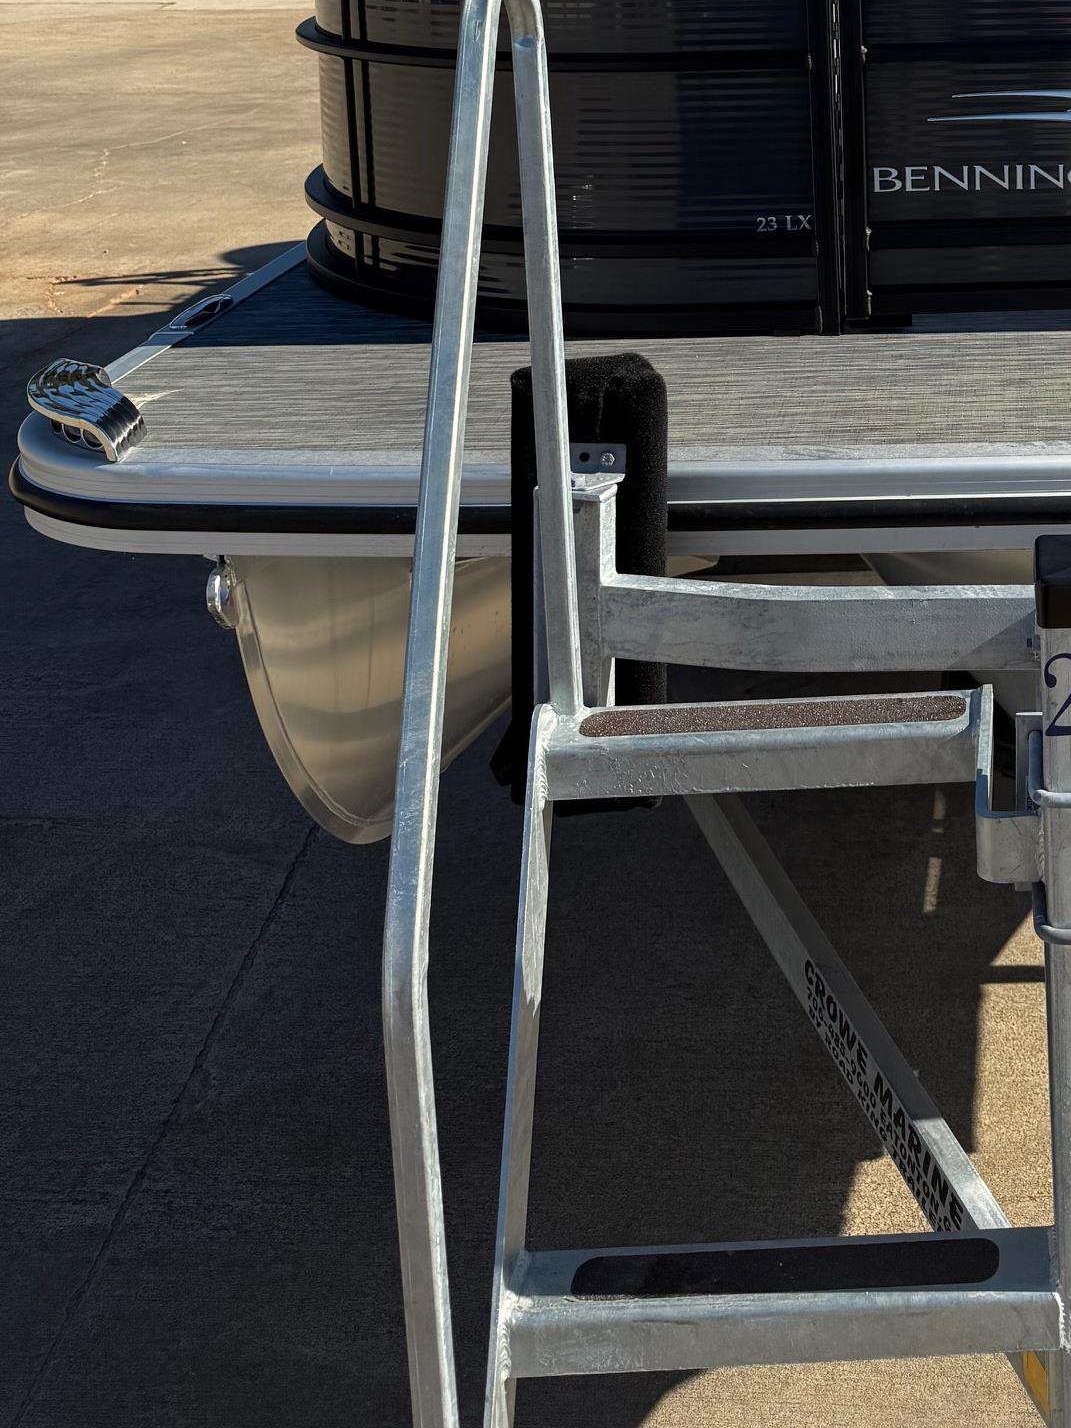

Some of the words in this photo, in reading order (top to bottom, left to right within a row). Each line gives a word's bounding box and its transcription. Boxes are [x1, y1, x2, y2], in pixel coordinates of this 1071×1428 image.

[756, 216, 778, 232] 23
[784, 214, 813, 231] LX
[804, 959, 868, 1075] CROWE
[874, 1071, 963, 1231] MARINE
[807, 986, 876, 1108] 706-485-9600
[880, 1107, 951, 1232] EATONTON,G
[825, 1032, 854, 1084] ROAD
[857, 1089, 887, 1141] KING
